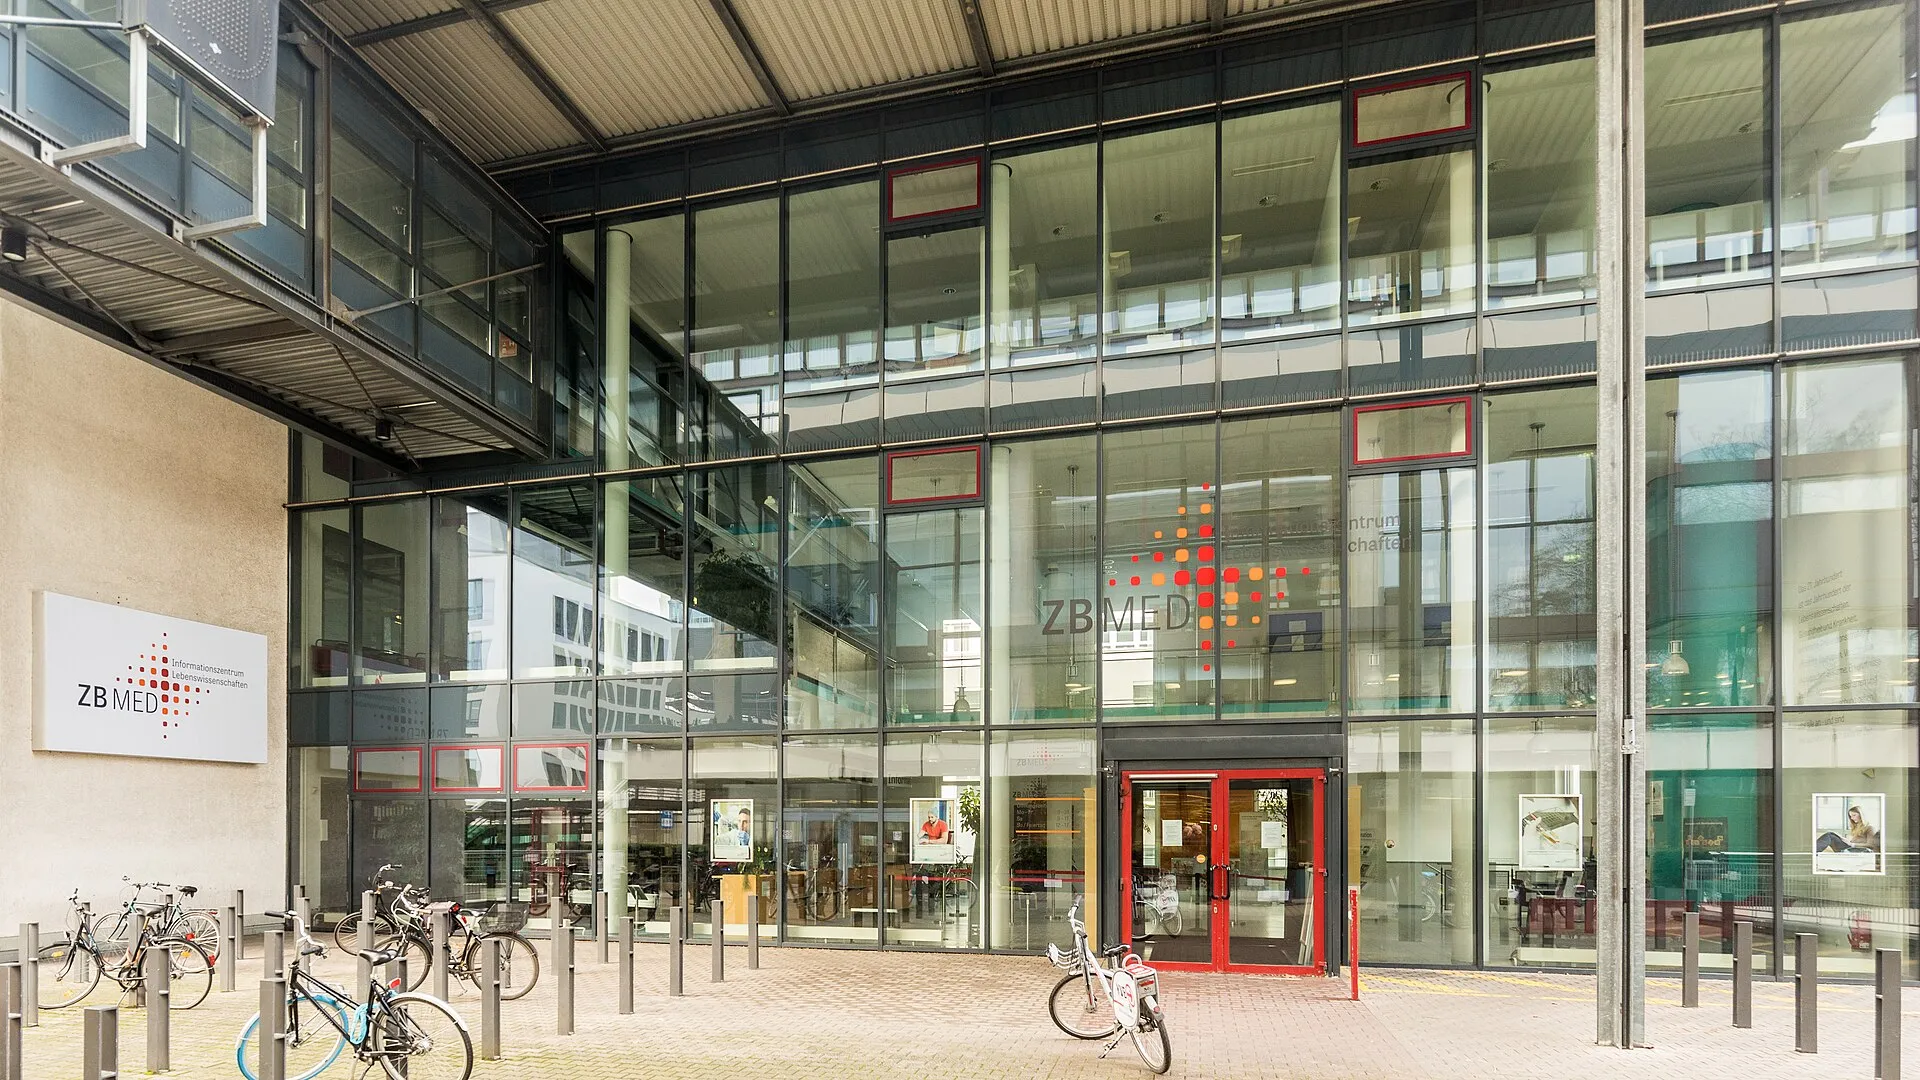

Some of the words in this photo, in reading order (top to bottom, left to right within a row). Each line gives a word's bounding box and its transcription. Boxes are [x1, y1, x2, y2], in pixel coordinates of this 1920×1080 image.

[1042, 598, 1093, 635] ZB
[1103, 594, 1190, 633] MED
[172, 658, 245, 678] Informationszentrum
[172, 670, 249, 689] Lebenswissenschaften
[77, 683, 108, 709] ZB
[112, 688, 158, 714] MED
